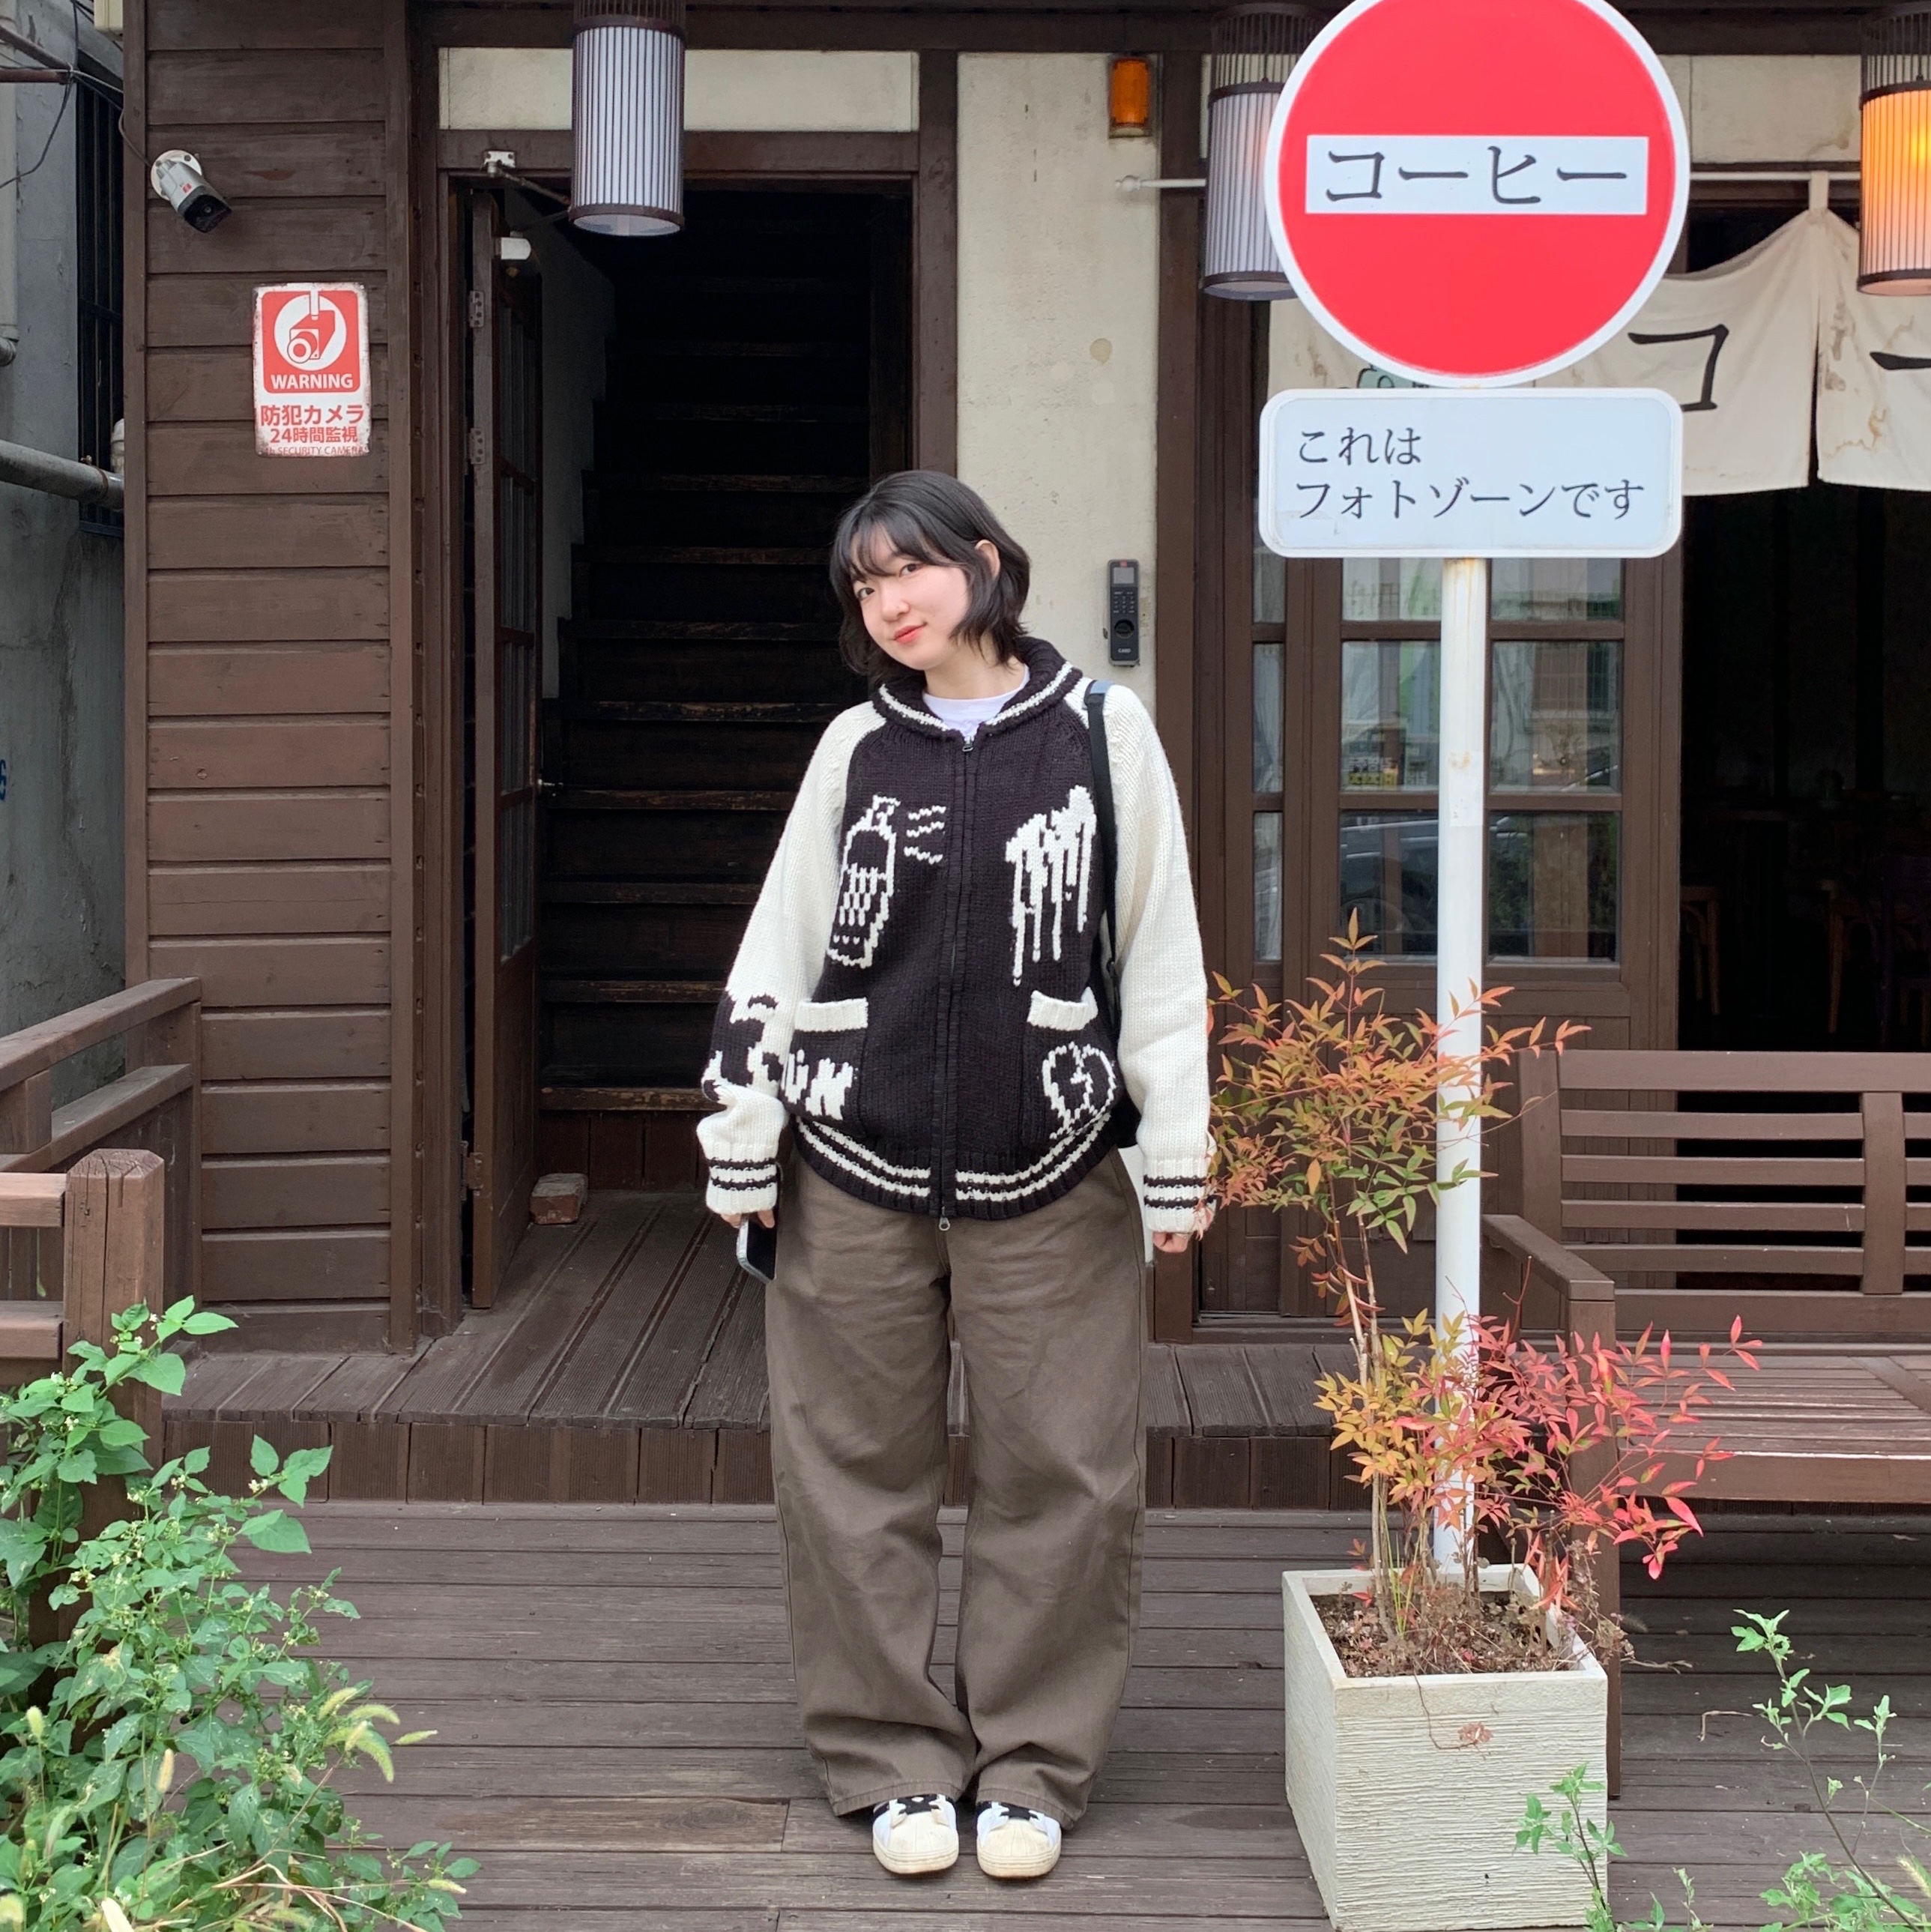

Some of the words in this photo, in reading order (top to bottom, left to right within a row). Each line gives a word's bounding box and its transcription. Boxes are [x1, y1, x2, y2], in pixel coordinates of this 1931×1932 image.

[1326, 145, 1627, 205] コーヒー
[271, 374, 353, 389] WARNING
[260, 405, 364, 426] 防犯カメラ
[271, 426, 357, 443] 24時間監視
[277, 447, 322, 456] SECURITY
[1299, 427, 1421, 465] これは
[1296, 477, 1645, 519] フォトゾーンです
